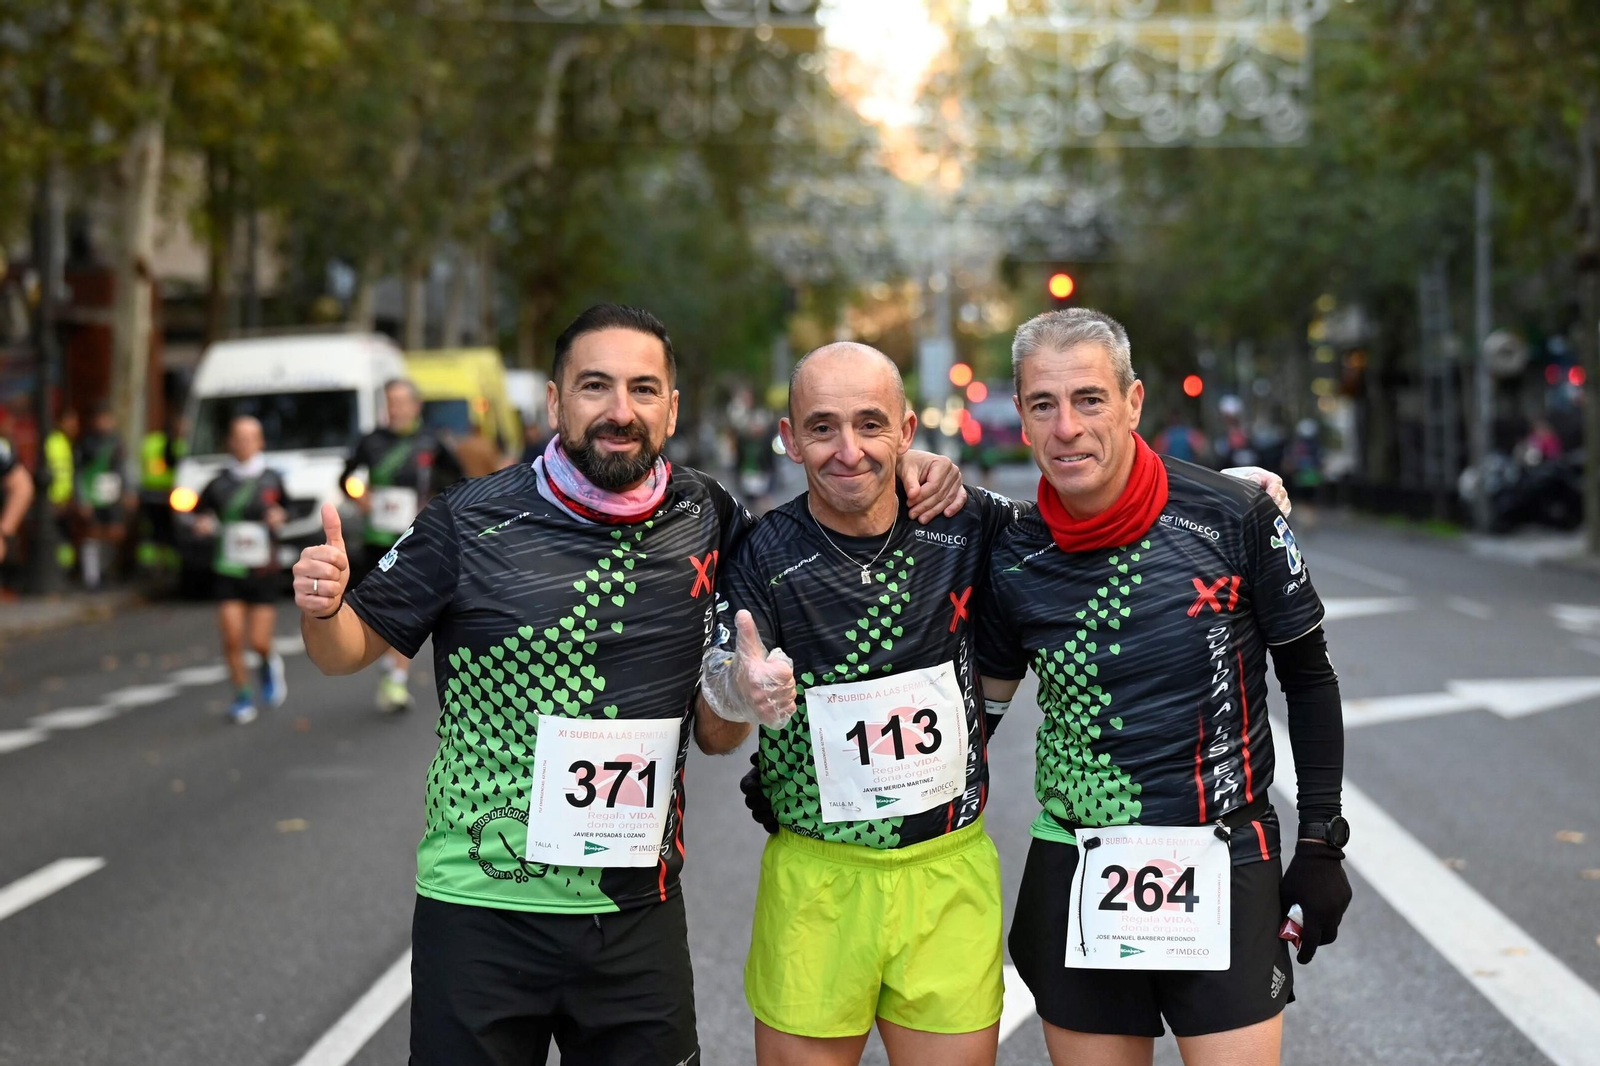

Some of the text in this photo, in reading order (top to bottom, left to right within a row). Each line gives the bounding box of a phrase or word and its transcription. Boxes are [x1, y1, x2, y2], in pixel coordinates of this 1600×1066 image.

[1174, 516, 1220, 540] IMDECO
[926, 530, 968, 546] IMDECO
[1186, 575, 1242, 618] XI
[1206, 625, 1230, 698] SUBIDA
[837, 692, 873, 703] SUBIDA
[874, 690, 881, 698] A
[883, 686, 901, 697] LAS
[1213, 702, 1231, 718] A
[557, 729, 670, 740] XI SUBIDA A LAS ERMITAS
[846, 708, 943, 766] 113
[871, 763, 911, 775] Regala
[873, 763, 947, 784] dona órganos
[565, 760, 657, 809] 371
[862, 776, 934, 794] JAVIER MERIDA MARTINEZ
[929, 780, 955, 796] IMDECO
[491, 809, 506, 819] DEL
[588, 811, 625, 821] Regala
[587, 821, 660, 831] dona órganos
[535, 841, 552, 849] TALLA
[1105, 837, 1133, 846] SUBIDA
[1136, 837, 1143, 845] A
[1145, 837, 1164, 846] LAS
[1166, 838, 1207, 847] ERMITAS
[1098, 864, 1200, 913] 264
[1121, 915, 1160, 925] Regala
[1121, 924, 1150, 932] dona
[1175, 948, 1210, 956] IMDECO
